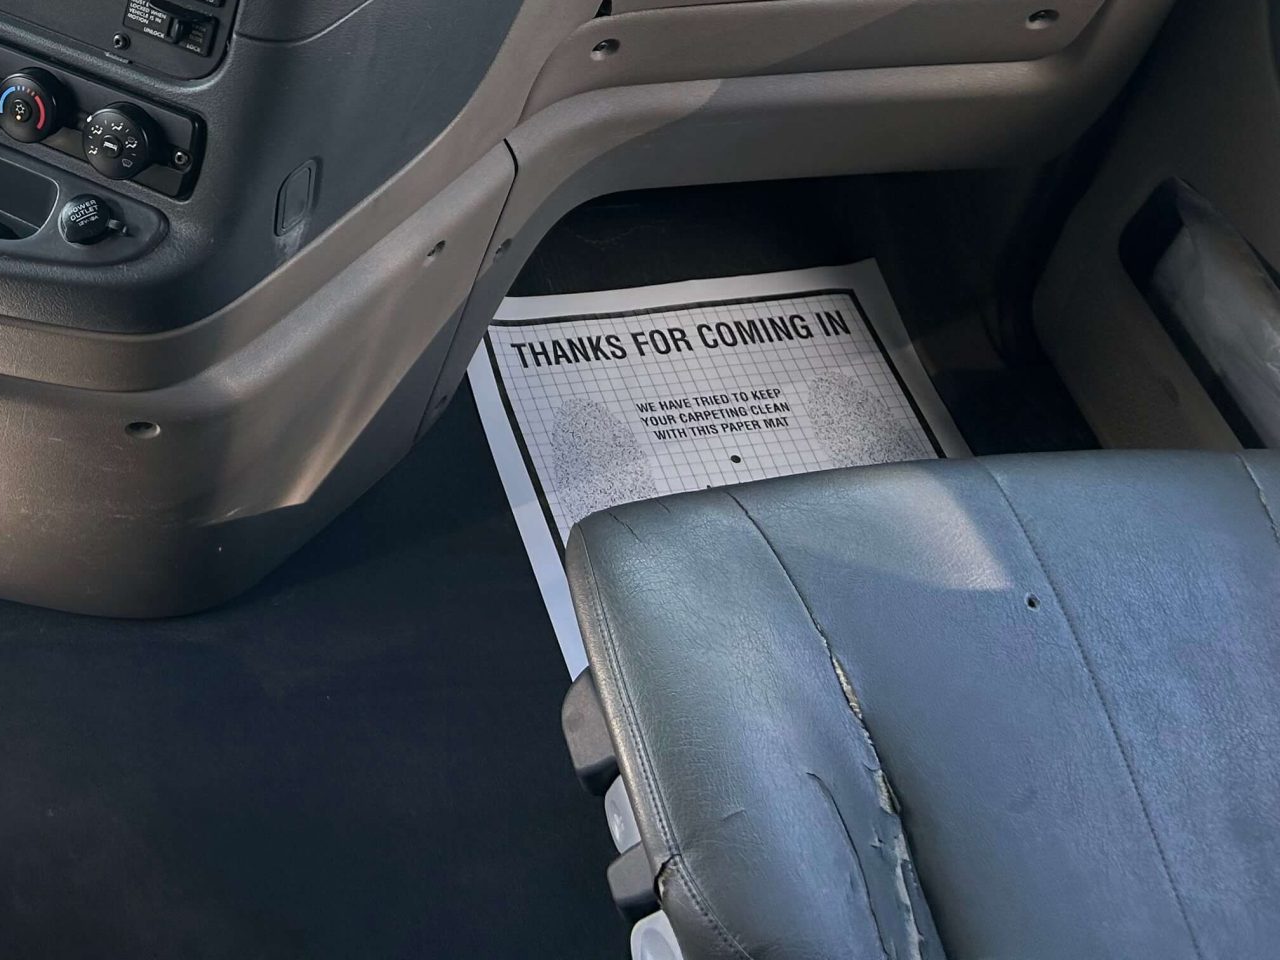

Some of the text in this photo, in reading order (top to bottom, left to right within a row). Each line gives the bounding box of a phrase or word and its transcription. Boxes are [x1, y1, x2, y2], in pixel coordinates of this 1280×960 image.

[128, 12, 149, 24] MOTION
[129, 8, 149, 18] VEHICLE
[130, 2, 150, 13] LOCKED
[151, 9, 167, 19] WHEN
[144, 26, 165, 39] UNLOCK
[186, 44, 201, 53] LOCK
[69, 200, 97, 215] POWER
[70, 204, 99, 221] OUTLET
[510, 310, 852, 368] THANKS FOR COMING IN
[636, 388, 781, 413] WE HAVE TRIED TO KEEP
[640, 402, 790, 427] YOUR CARPETING CLEAN
[654, 416, 790, 440] WITH THIS PAPER MAT
